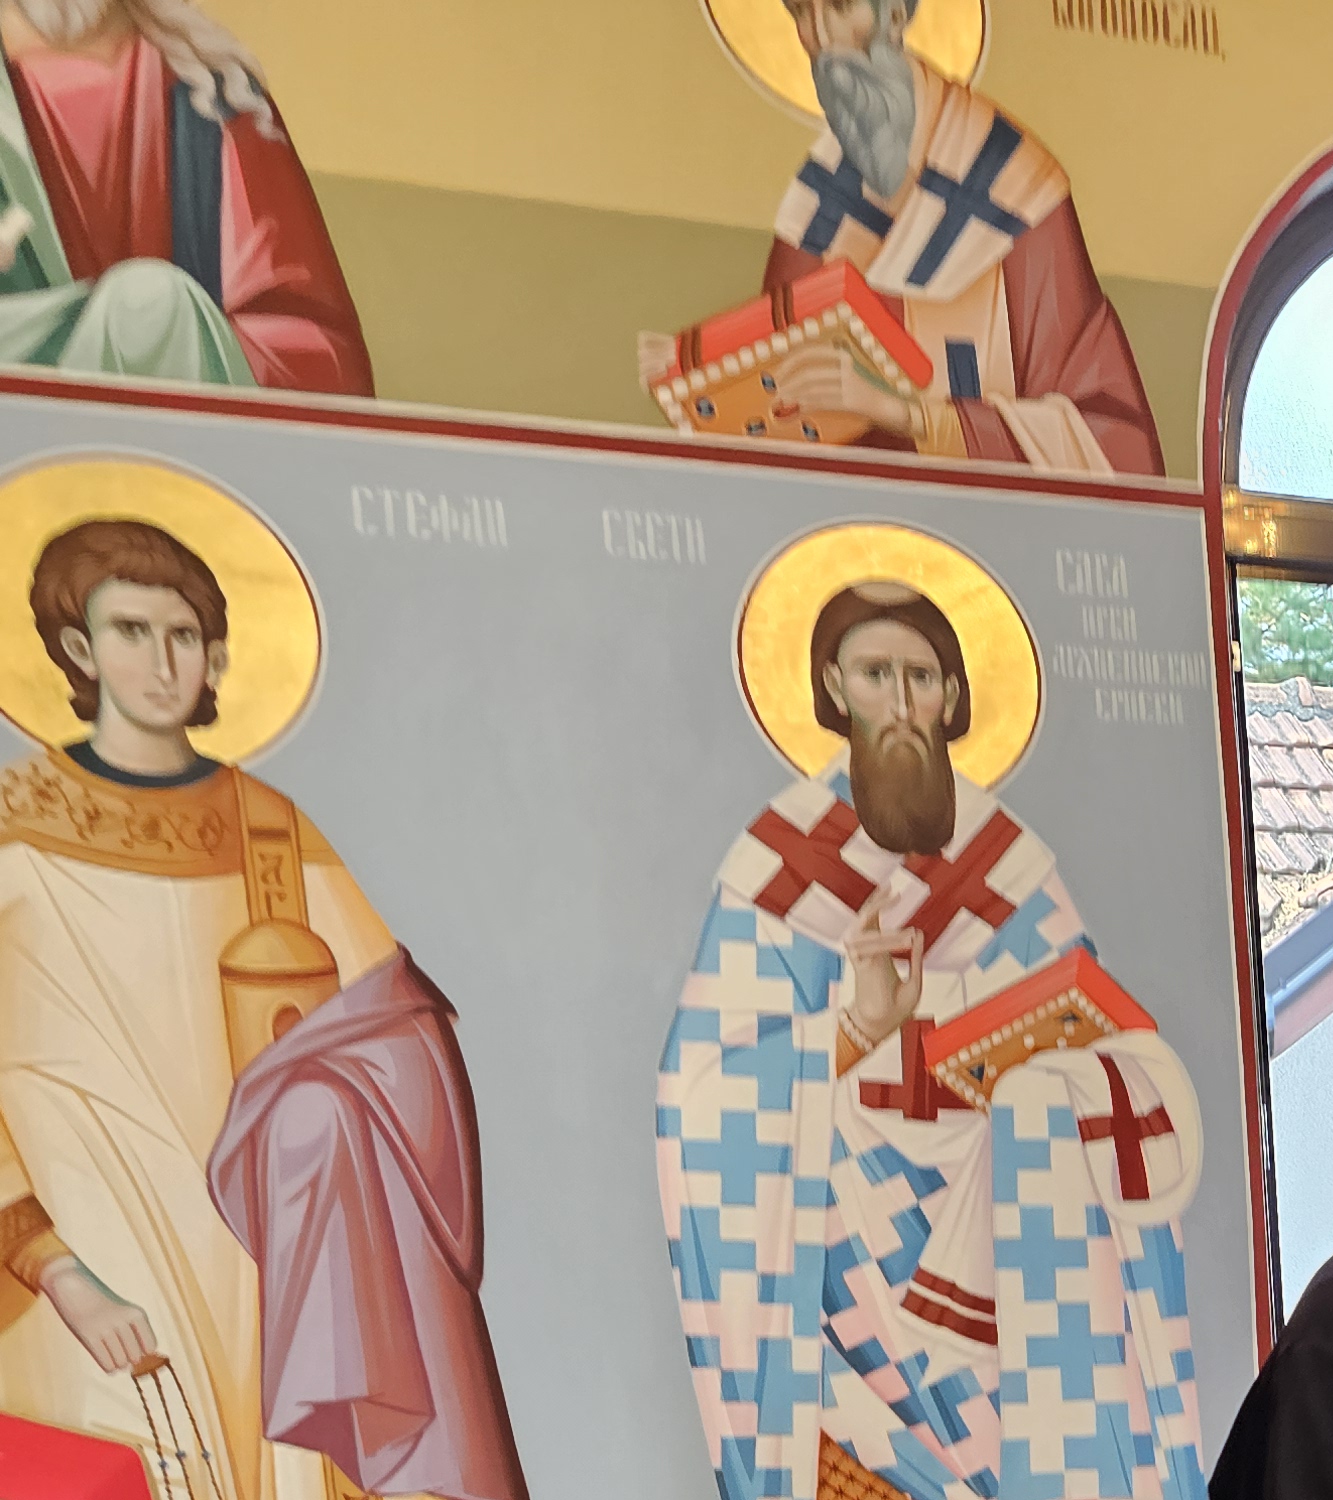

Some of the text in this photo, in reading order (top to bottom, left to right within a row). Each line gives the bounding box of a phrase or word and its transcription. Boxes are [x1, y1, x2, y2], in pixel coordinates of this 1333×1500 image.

[351, 485, 508, 548] СТЕФАН
[601, 508, 706, 565] СВЕТИ
[1056, 549, 1129, 598] САВА
